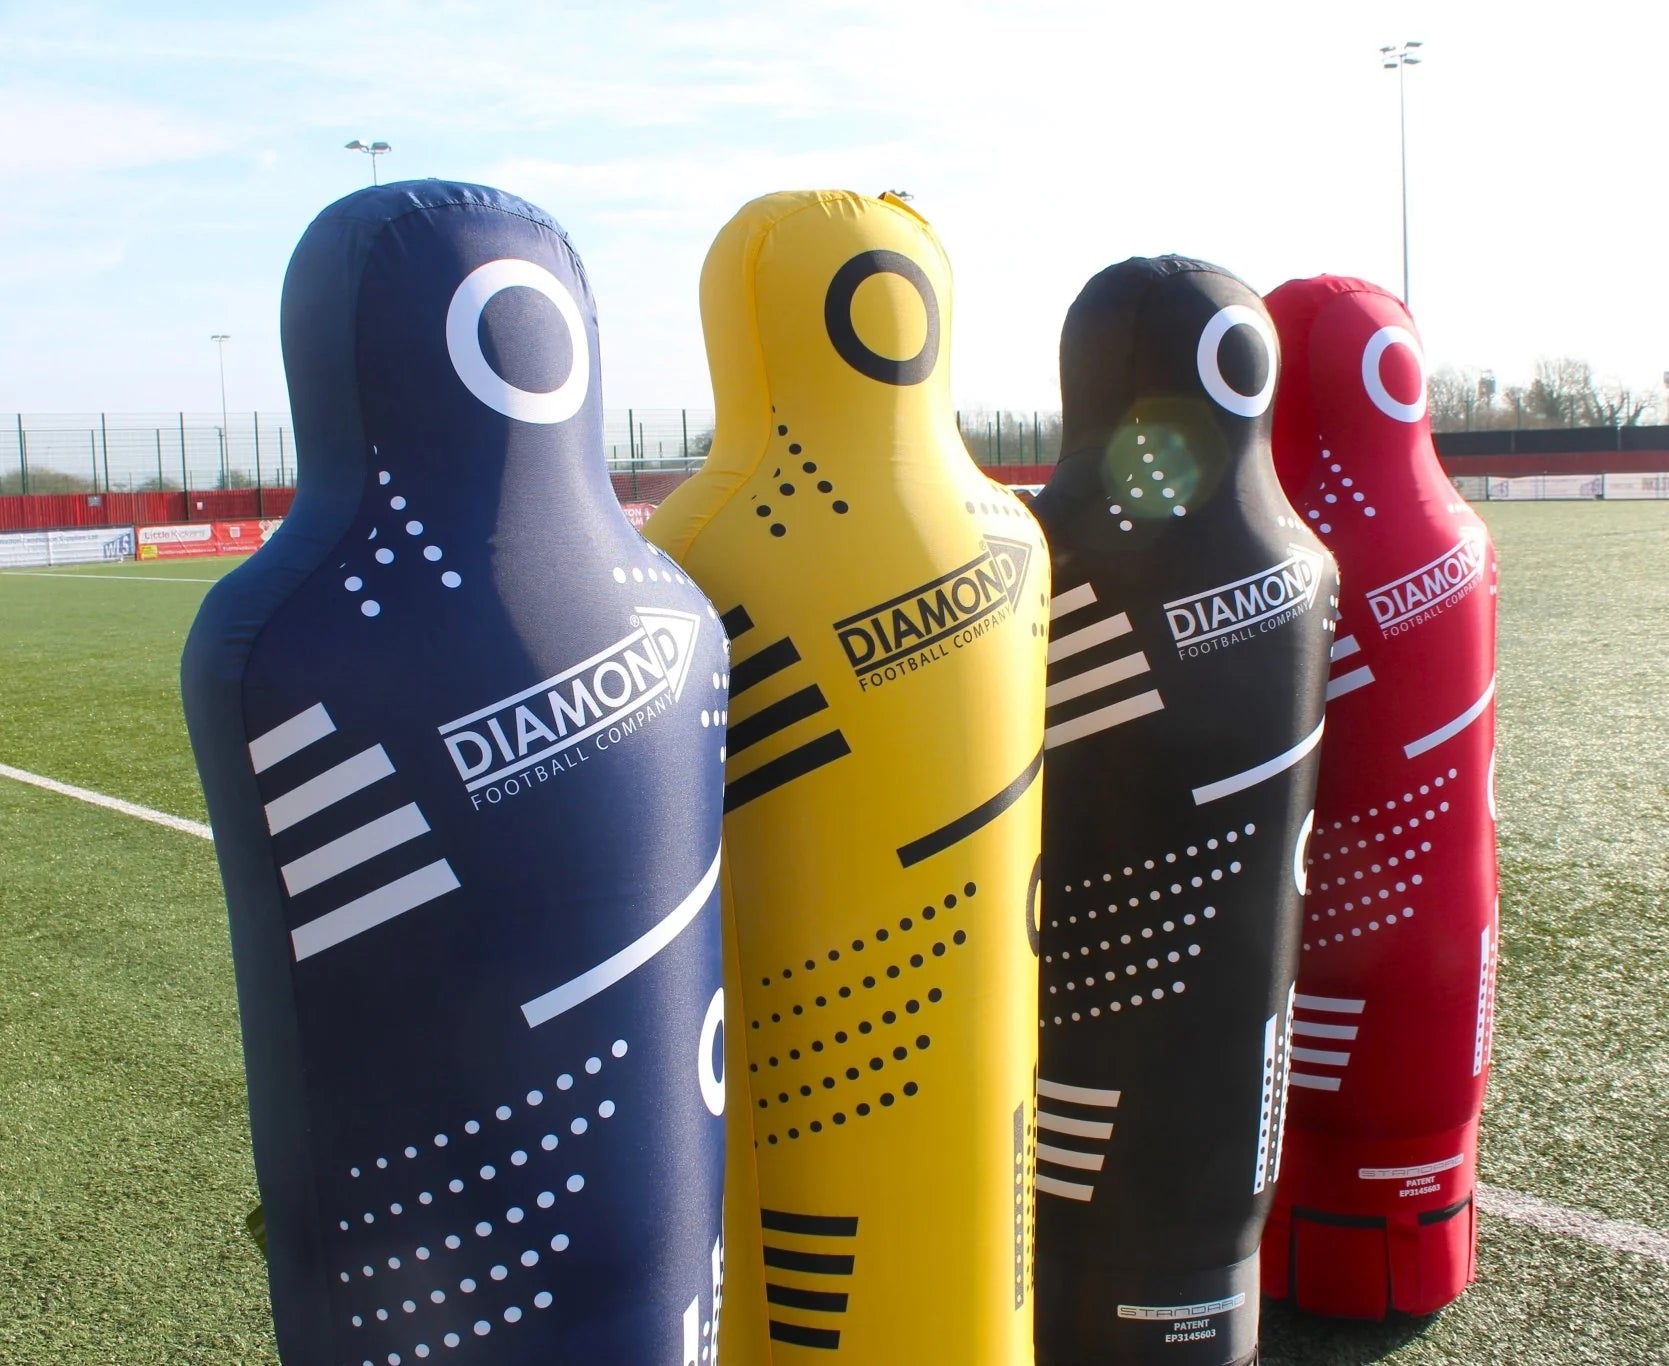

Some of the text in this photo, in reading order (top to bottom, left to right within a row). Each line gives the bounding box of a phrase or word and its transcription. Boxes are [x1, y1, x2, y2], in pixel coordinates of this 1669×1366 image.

[838, 552, 1017, 668] DIAMOND
[1165, 558, 1314, 641] DIAMOND
[1368, 540, 1480, 624] DIAMOND
[1382, 574, 1483, 640] FOOTBALL COMPANY
[858, 604, 1011, 692] FOOTBALL COMPANY
[1178, 601, 1310, 661] FOOTBALL COMPANY
[443, 626, 680, 782] DIAMOND
[470, 690, 676, 811] FOOTBALL COMPANY
[1360, 1156, 1464, 1178] STANDARD
[1399, 1184, 1440, 1198] EP3145603
[1405, 1175, 1436, 1187] PATENT
[1119, 1295, 1245, 1317] STANDARD
[1165, 1329, 1216, 1343] EP3145603
[1173, 1319, 1211, 1331] PATENT
